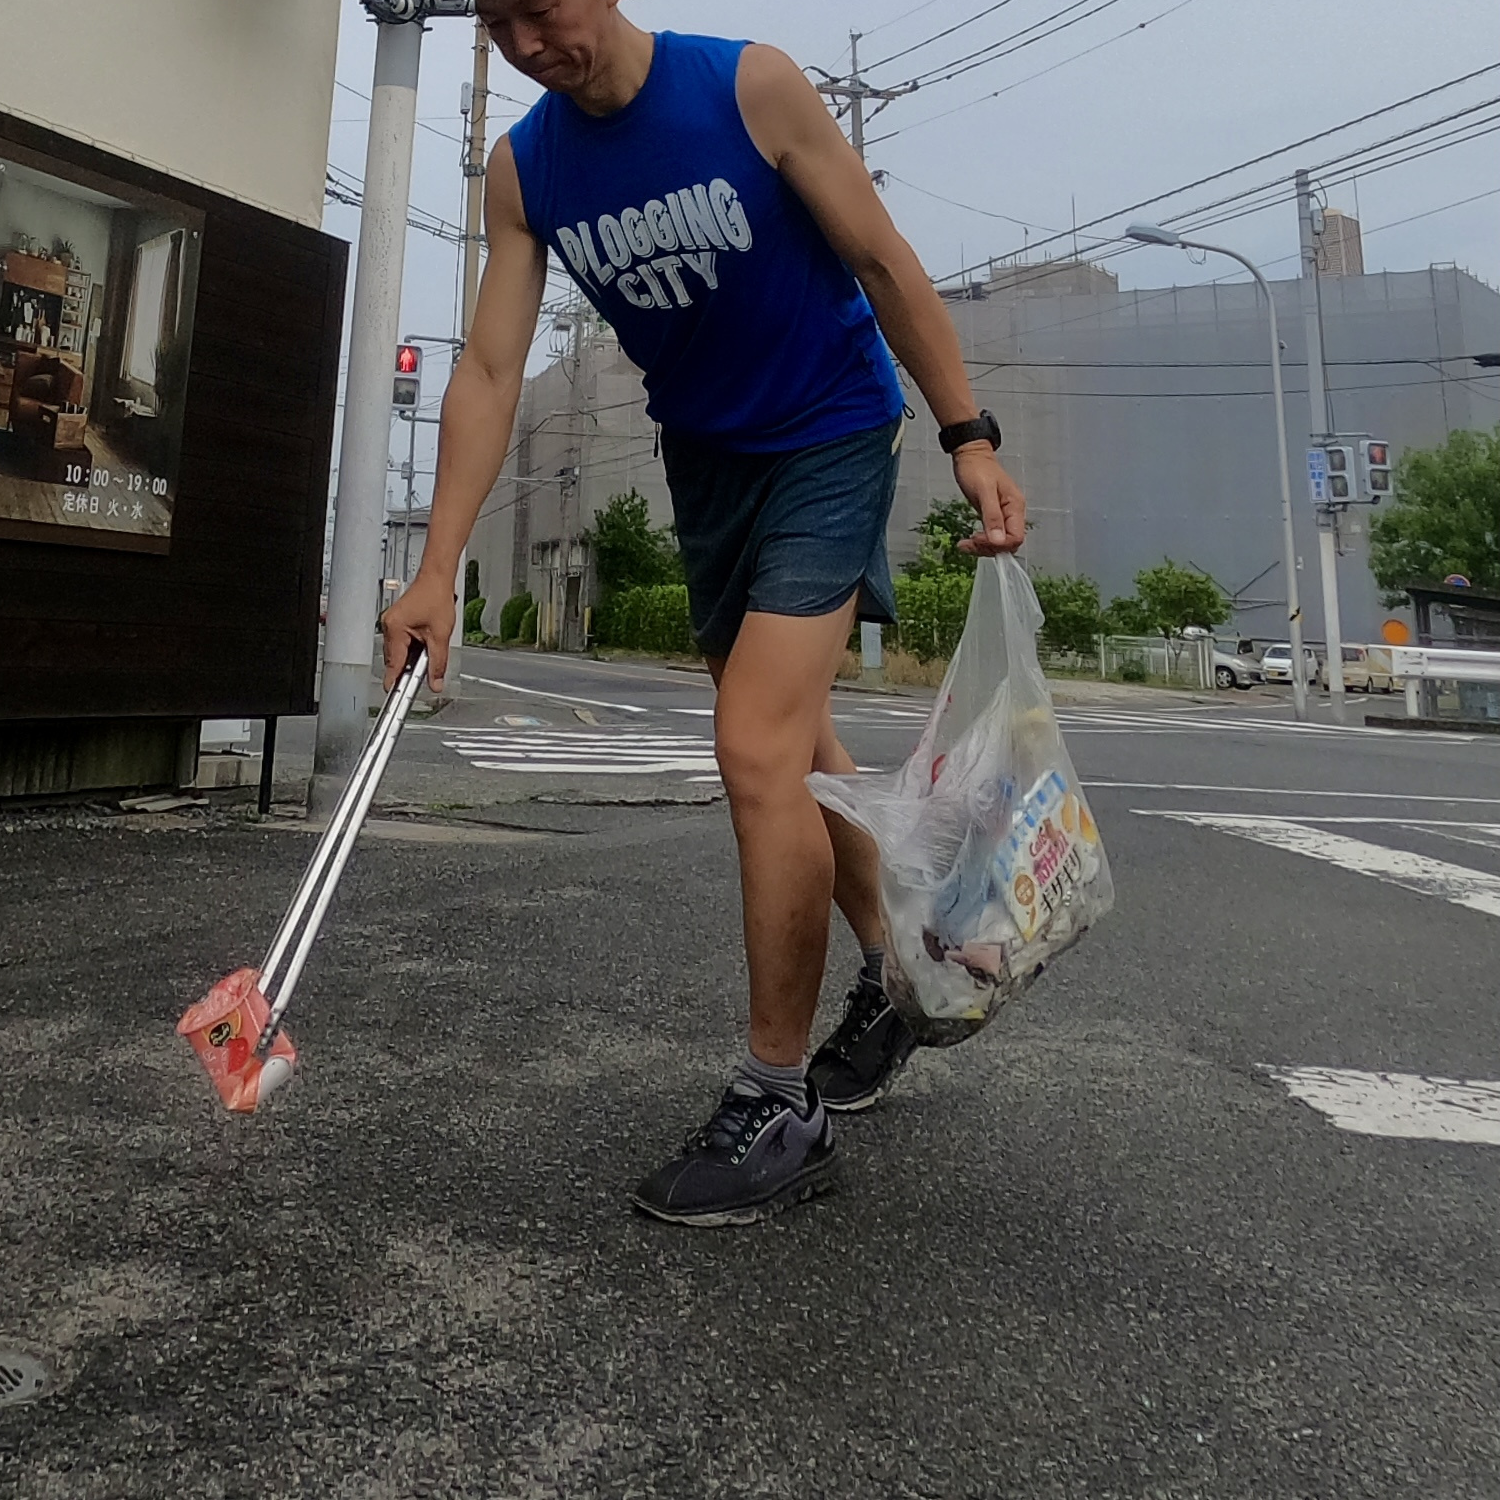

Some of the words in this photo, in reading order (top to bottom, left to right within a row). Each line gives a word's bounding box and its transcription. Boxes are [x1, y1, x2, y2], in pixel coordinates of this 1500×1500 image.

[556, 177, 752, 298] PLOGGING
[616, 251, 719, 310] CITY
[62, 491, 100, 515] 定休日
